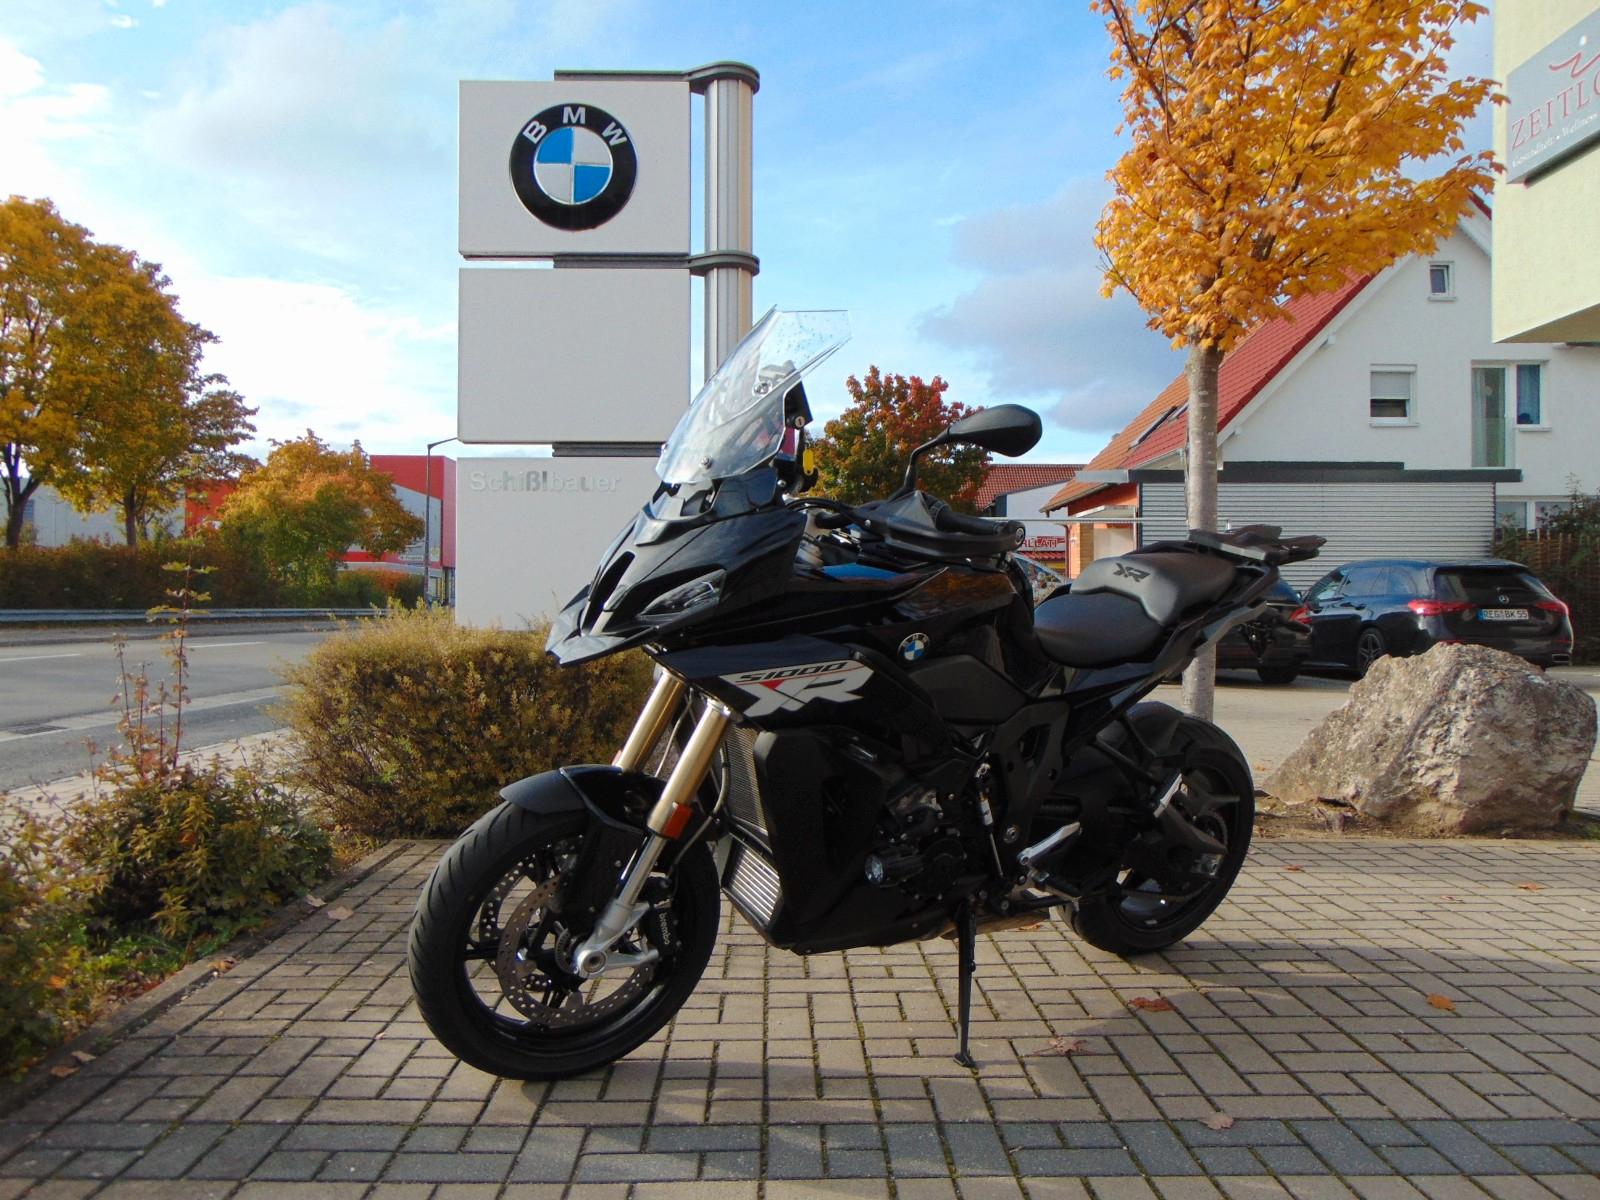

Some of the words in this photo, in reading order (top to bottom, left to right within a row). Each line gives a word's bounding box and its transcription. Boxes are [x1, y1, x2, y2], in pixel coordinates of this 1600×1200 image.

[522, 106, 628, 147] BMW
[470, 470, 621, 492] Schißlbauer
[1113, 563, 1151, 583] XR
[659, 912, 671, 945] brembo
